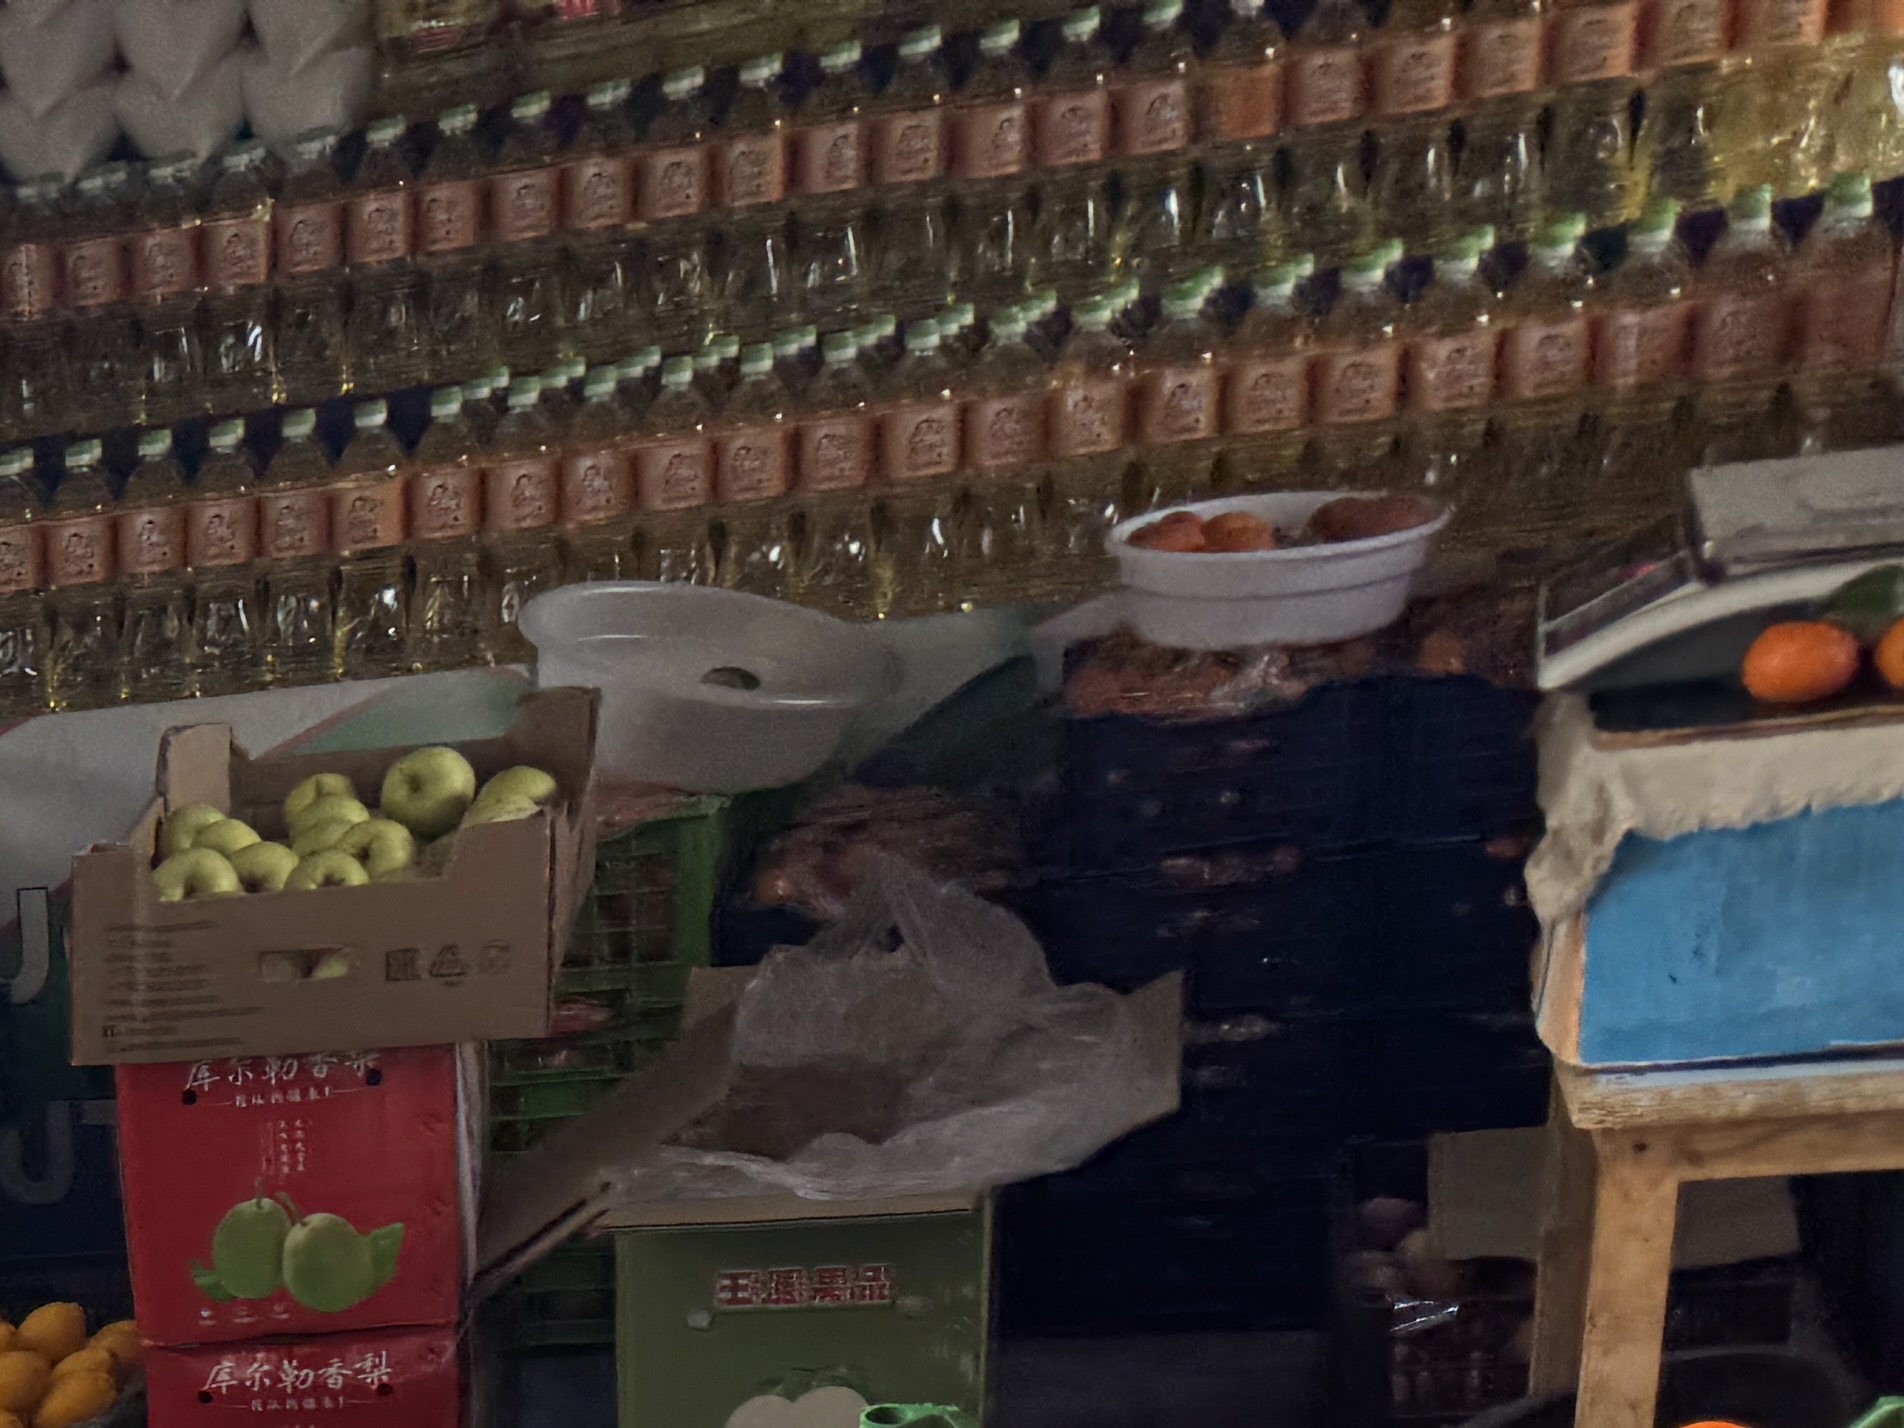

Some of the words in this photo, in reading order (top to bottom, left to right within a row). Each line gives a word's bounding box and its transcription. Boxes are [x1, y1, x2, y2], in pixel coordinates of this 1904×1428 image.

[203, 1350, 392, 1394] 库尔勒香梨
